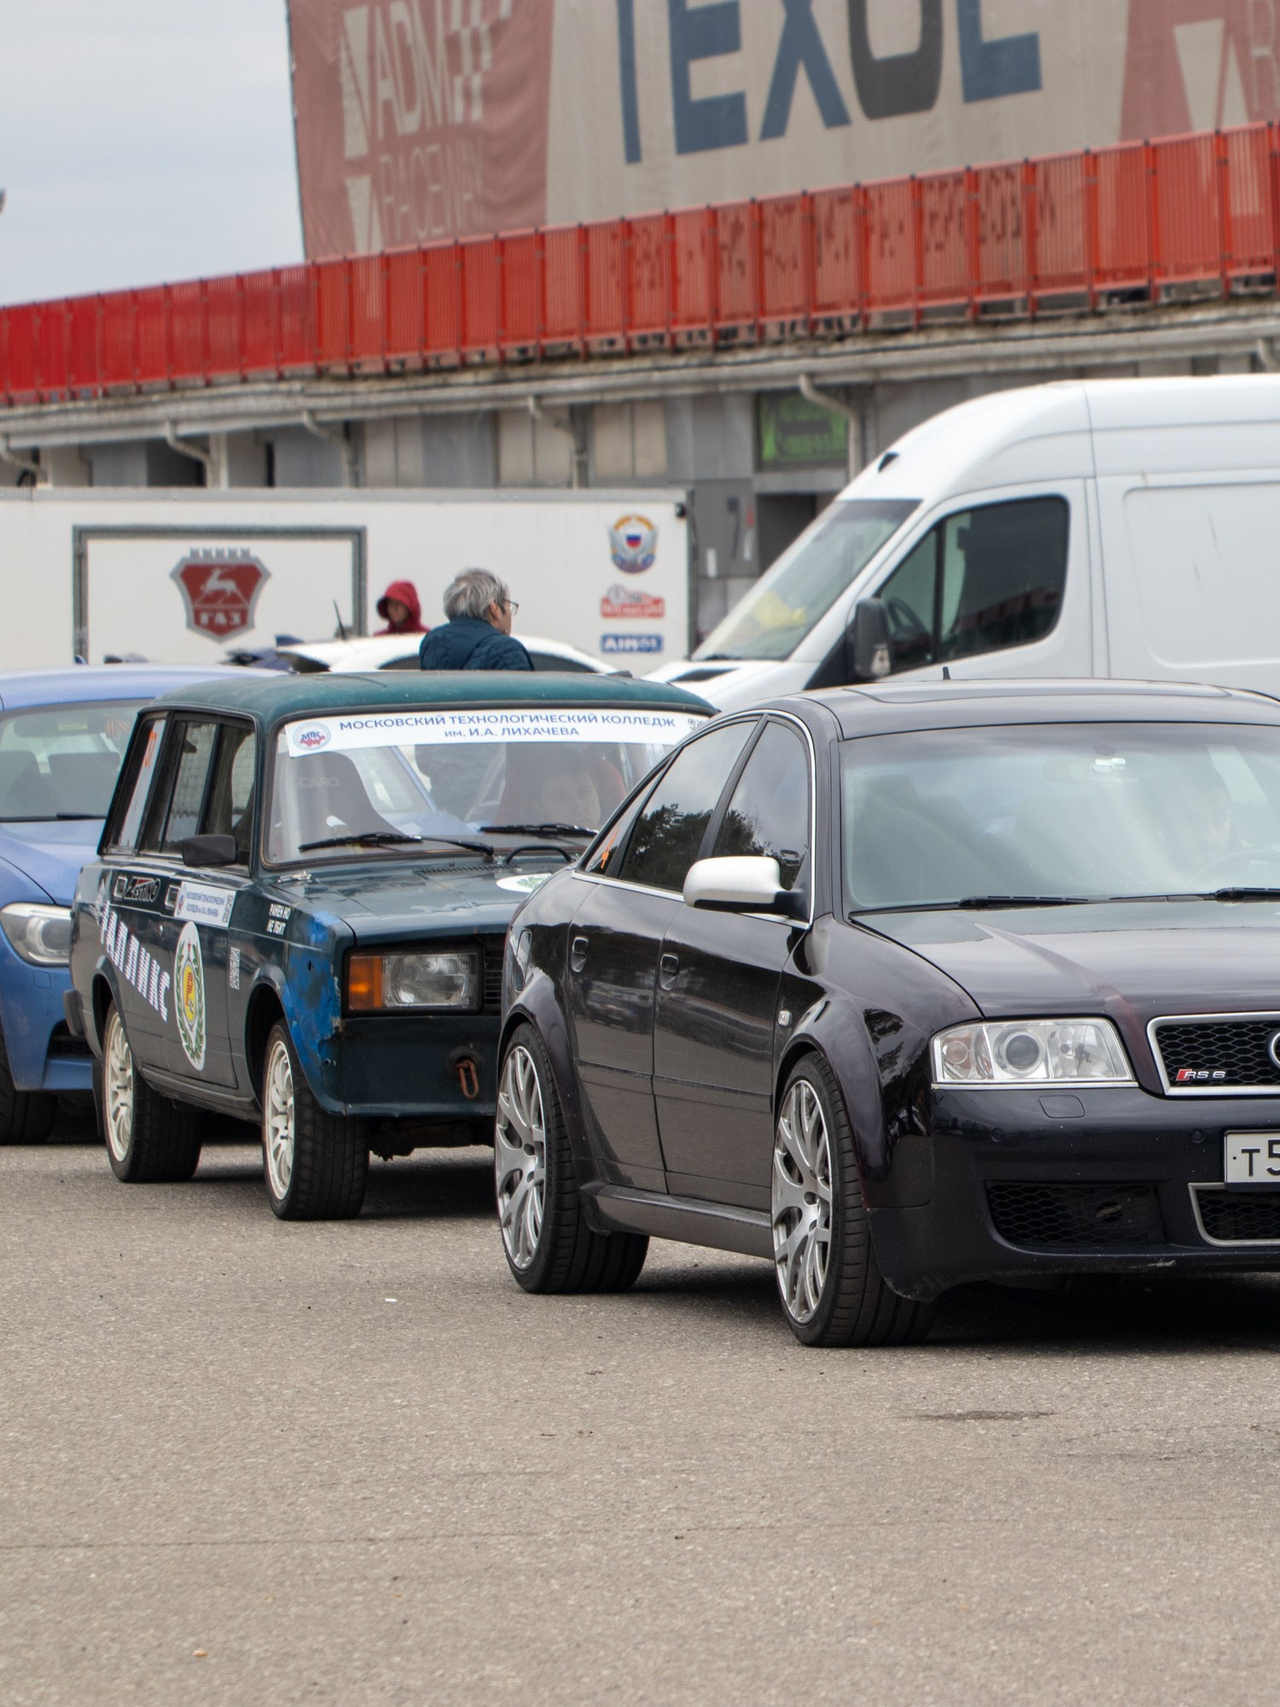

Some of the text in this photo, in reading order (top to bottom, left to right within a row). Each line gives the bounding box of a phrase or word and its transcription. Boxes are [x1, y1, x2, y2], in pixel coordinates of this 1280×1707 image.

[200, 611, 242, 626] ГАЗ
[340, 713, 676, 731] МОСКОВСКИЙ ТЕХНОЛОГИЧЕСКИЙ КОЛЛЕДЖ
[501, 727, 580, 737] ЛИХАЧЕВА
[292, 776, 340, 788] ECARO
[1183, 1070, 1226, 1079] RS 6
